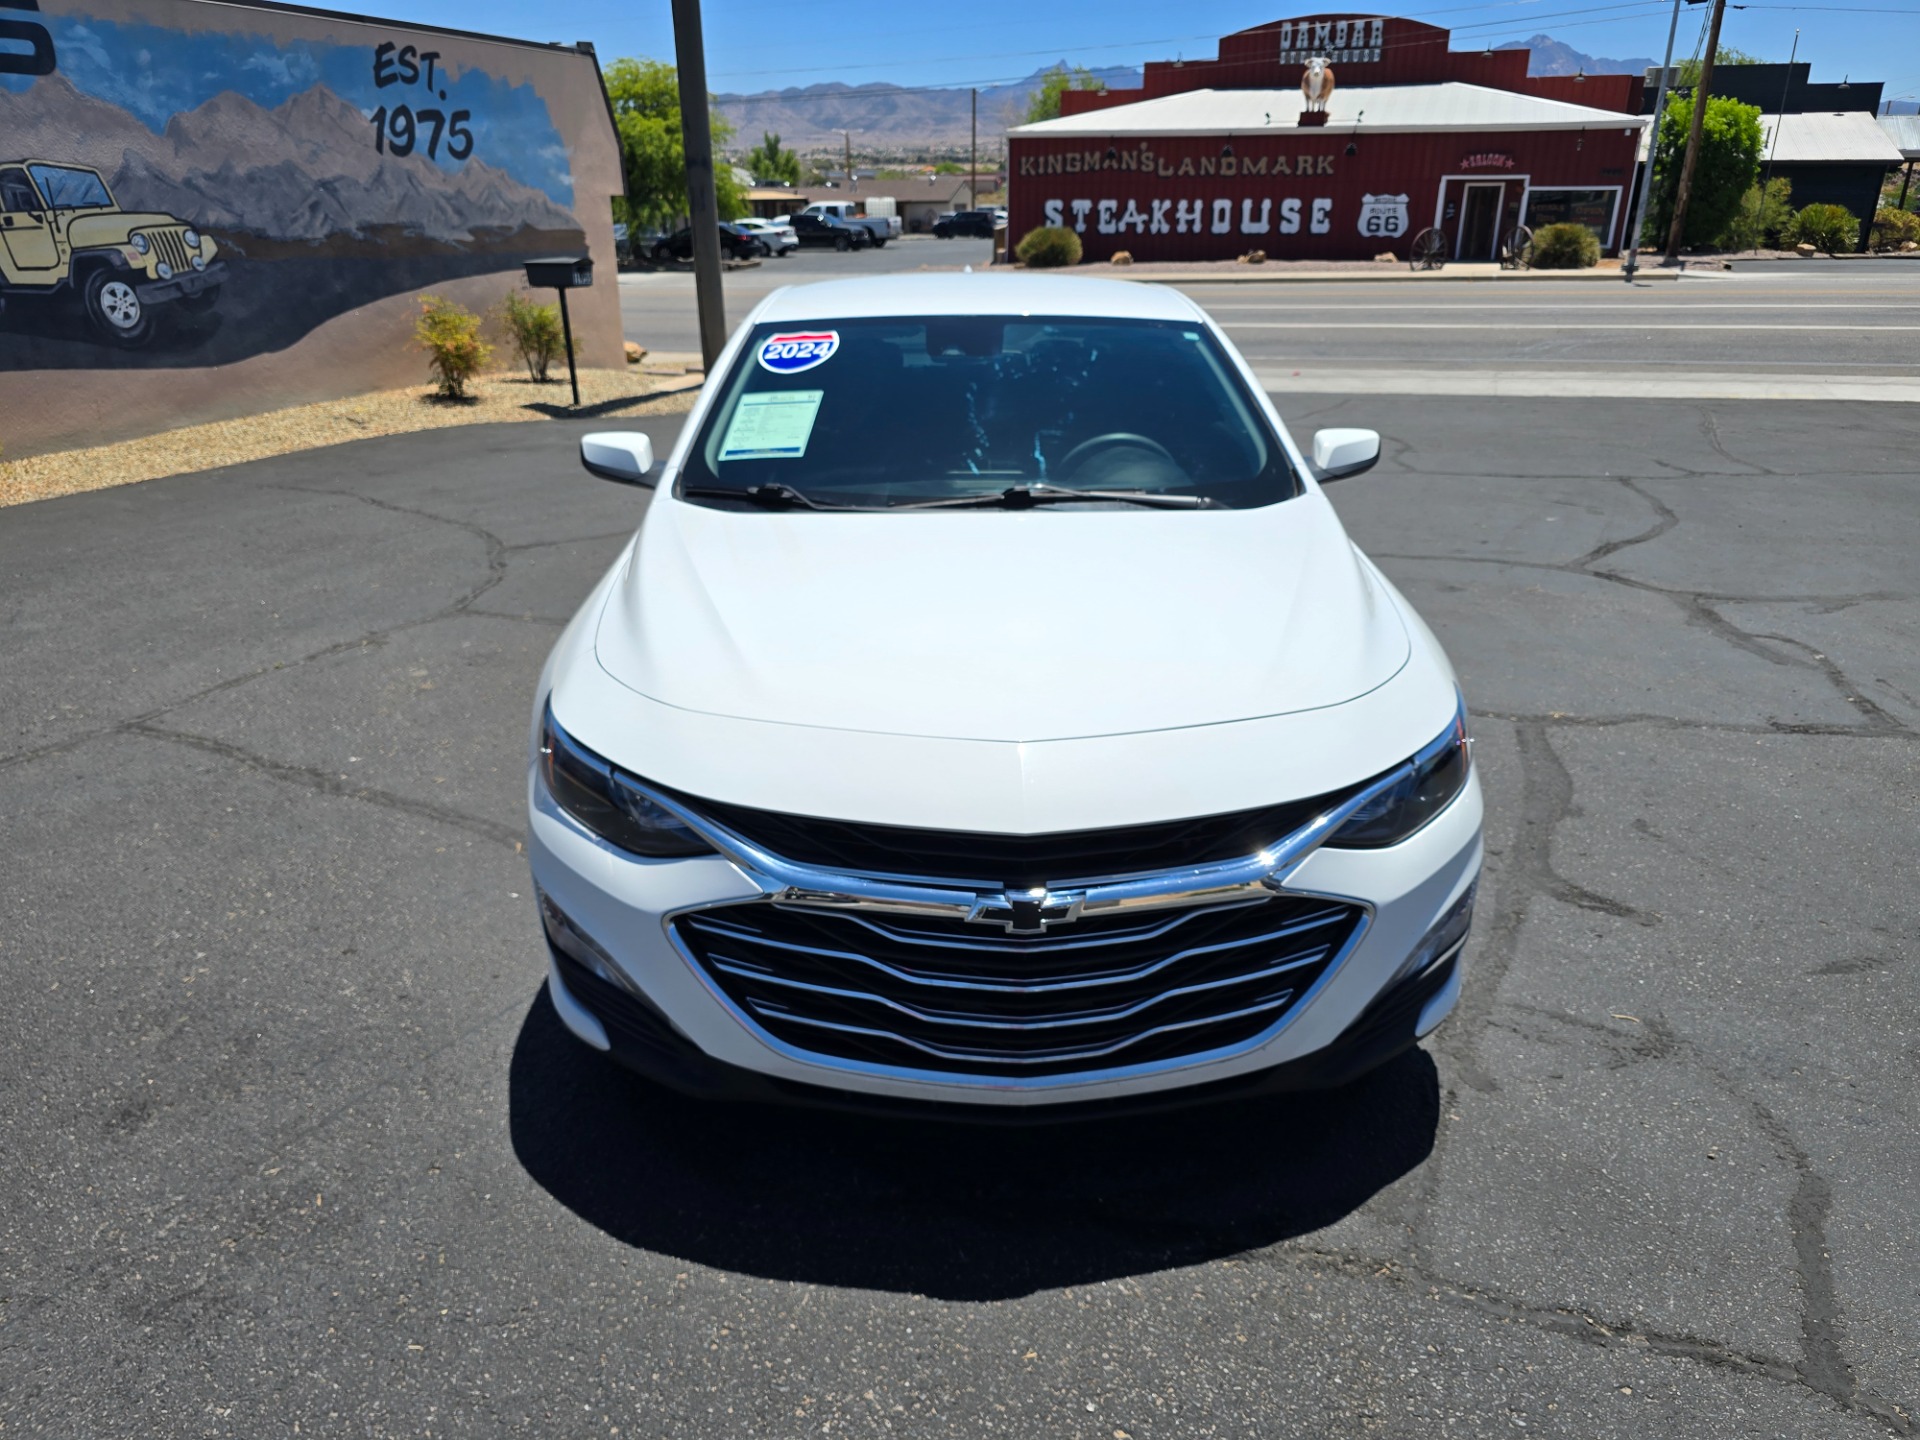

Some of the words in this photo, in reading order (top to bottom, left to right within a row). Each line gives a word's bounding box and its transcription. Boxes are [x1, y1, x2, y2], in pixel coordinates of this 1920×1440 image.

[1280, 21, 1383, 49] DAMBAR
[373, 41, 447, 101] EST.
[370, 104, 474, 161] 1975
[1020, 142, 1155, 176] KINGMAN'S
[1158, 155, 1335, 177] LANDMARK
[1044, 198, 1333, 234] STEAKHOUSE
[1367, 215, 1399, 233] 66
[1369, 207, 1398, 215] ROUTE
[764, 342, 831, 360] 2024
